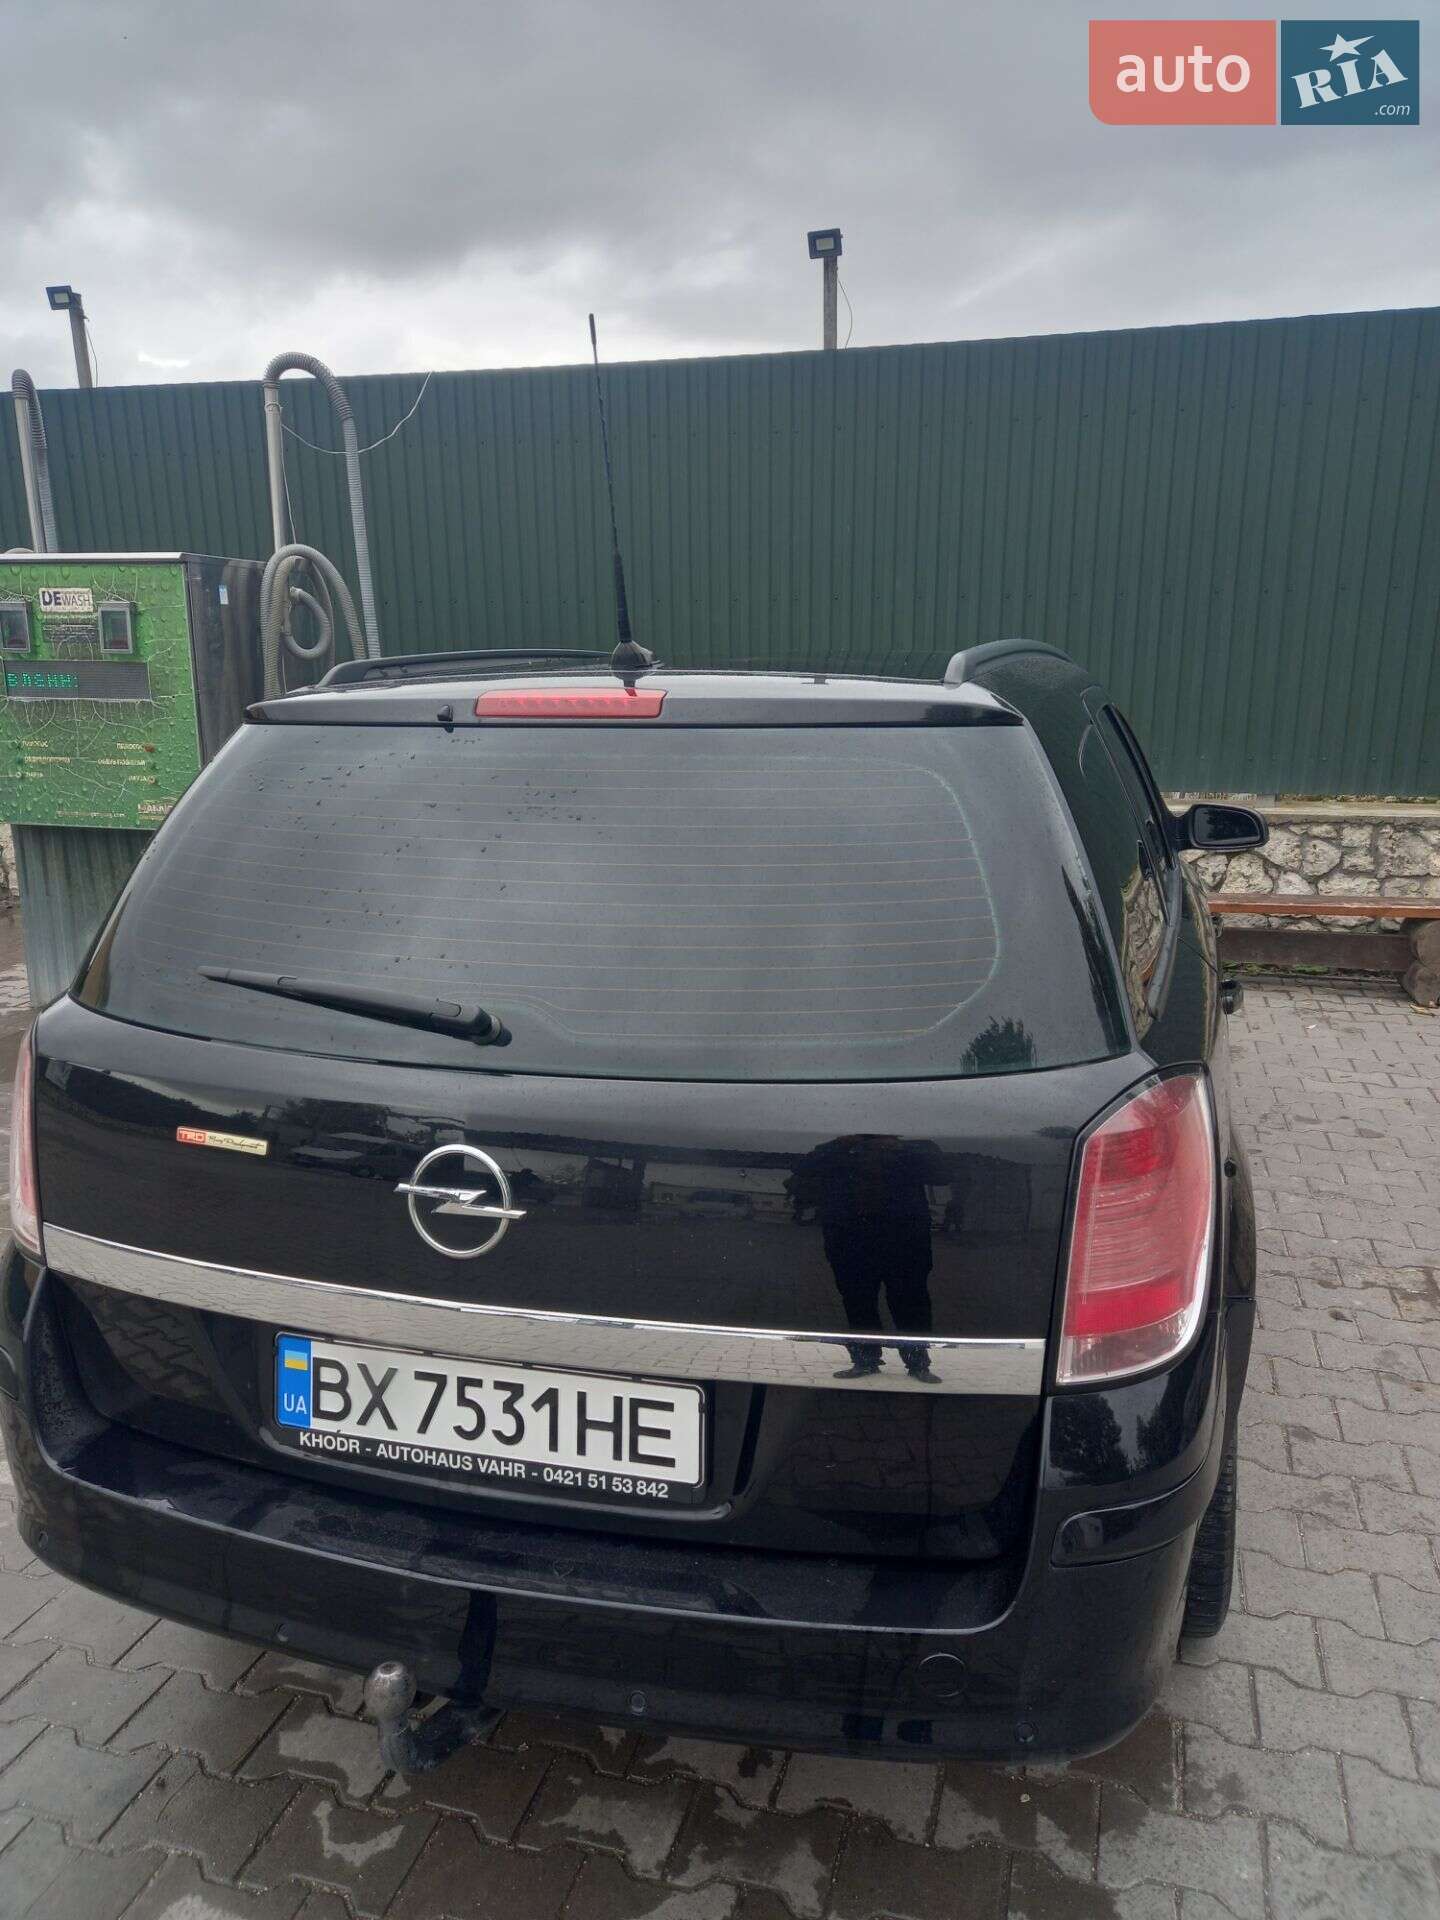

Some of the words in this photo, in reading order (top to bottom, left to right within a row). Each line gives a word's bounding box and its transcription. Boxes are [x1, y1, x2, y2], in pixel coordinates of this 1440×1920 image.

[283, 1392, 308, 1415] UA
[300, 1431, 361, 1454] KHODR
[376, 1442, 473, 1471] AUTOHAUS
[477, 1457, 526, 1479] VAHR
[543, 1466, 583, 1487] 0421
[587, 1474, 608, 1491] 51
[611, 1476, 633, 1495] 53
[636, 1479, 669, 1499] 842
